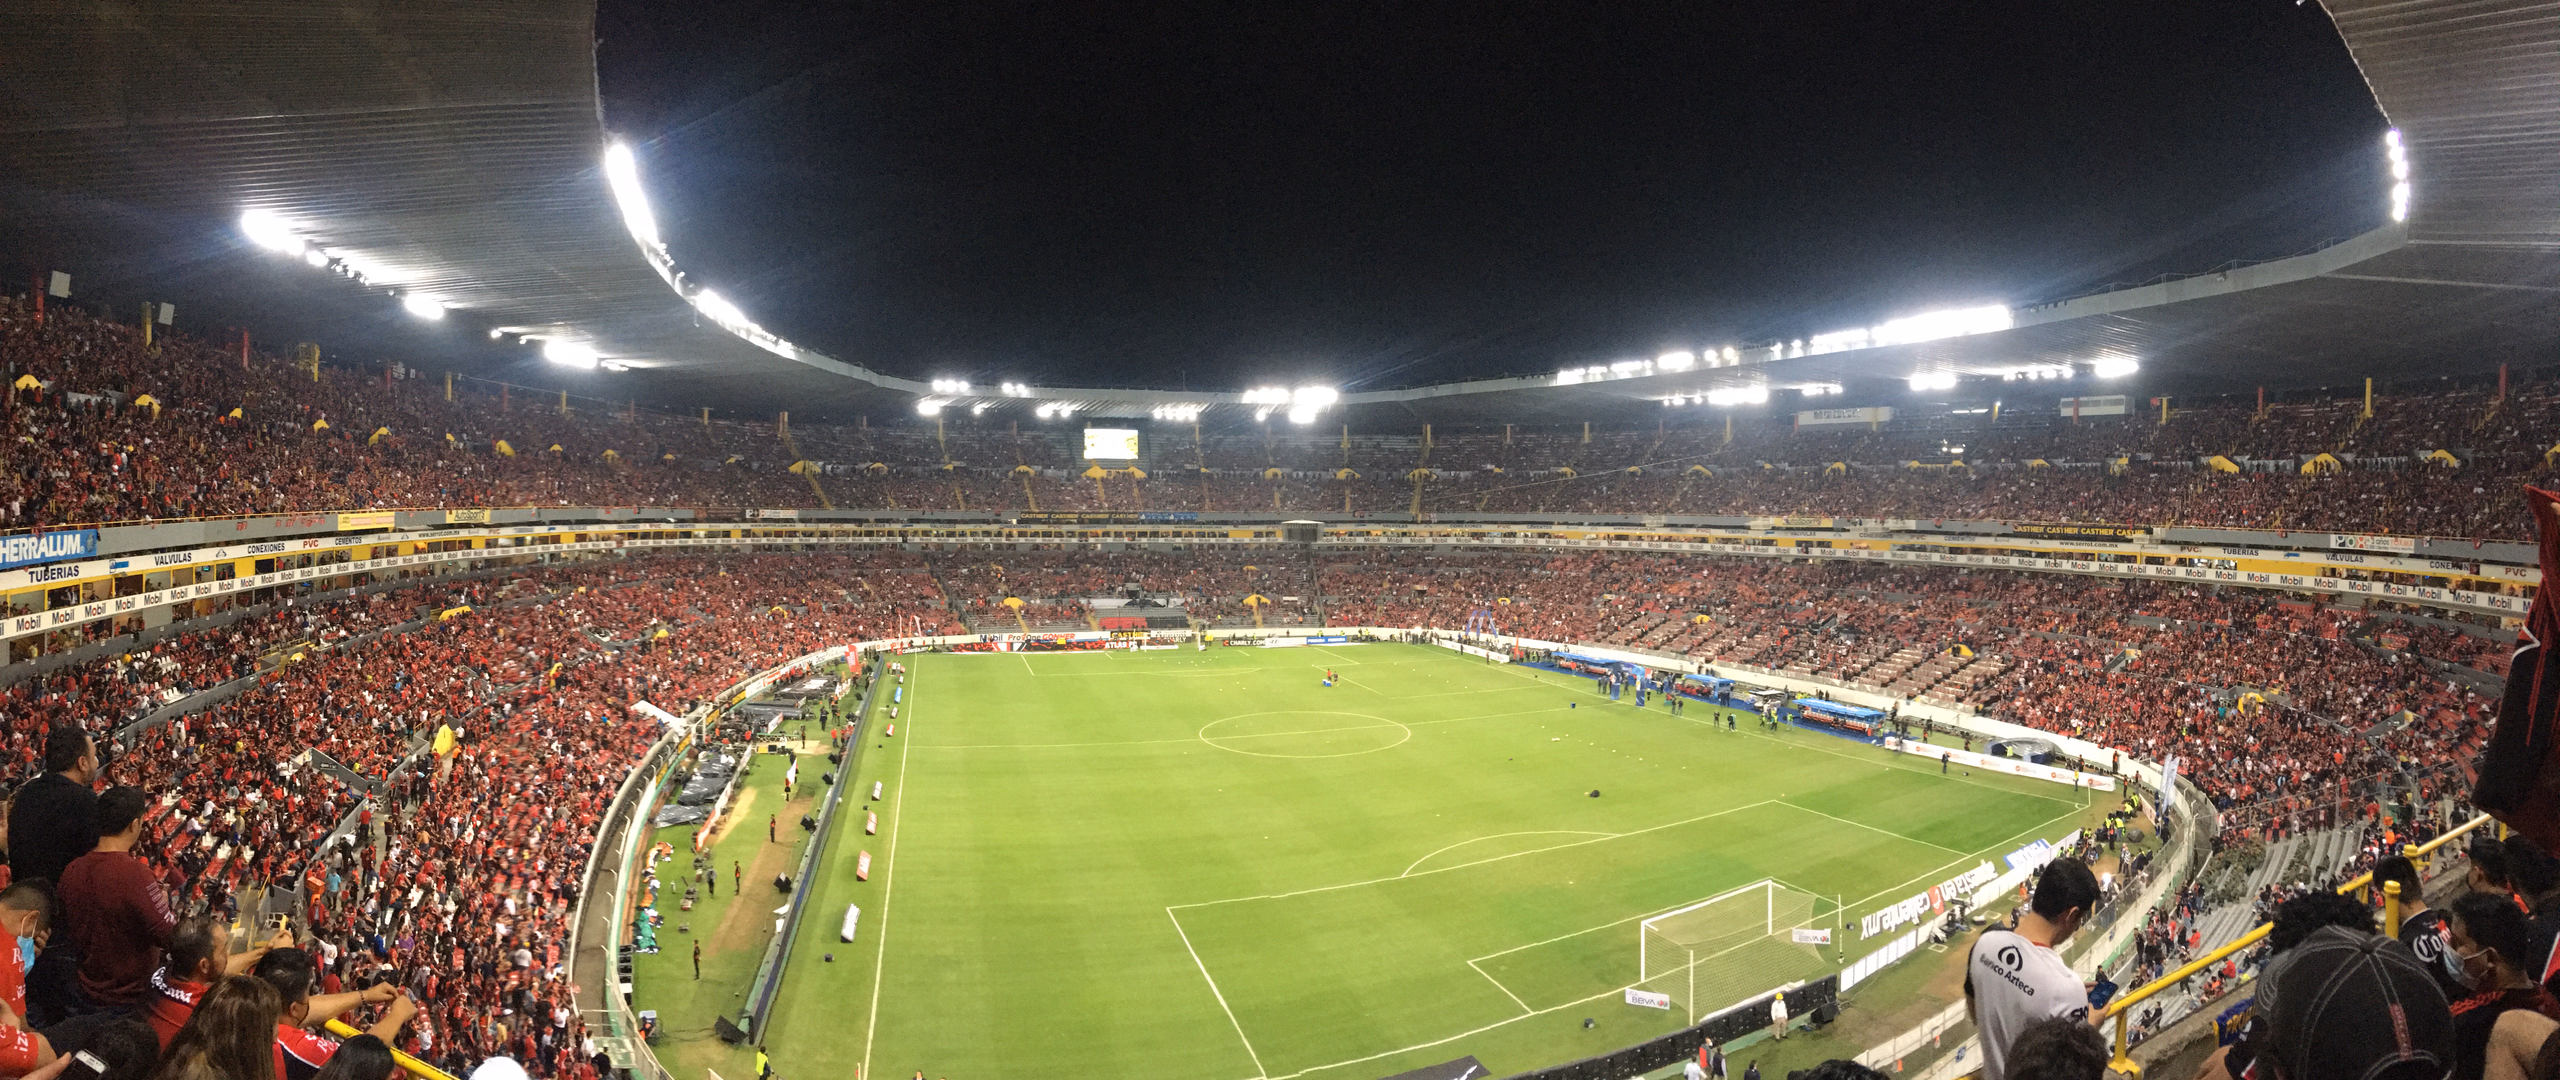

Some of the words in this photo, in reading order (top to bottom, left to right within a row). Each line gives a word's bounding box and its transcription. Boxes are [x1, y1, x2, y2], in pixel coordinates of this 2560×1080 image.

[2081, 527, 2113, 535] CASTHER
[303, 540, 318, 548] PVC
[335, 537, 362, 546] CEMENTOS
[0, 533, 81, 564] HERRALUM
[247, 543, 285, 554] CONEXIONES
[2222, 548, 2259, 556] TUBERIAS
[154, 553, 192, 566] VALVULAS
[371, 558, 382, 568] Mobil
[387, 556, 398, 566] Mobil
[2018, 558, 2036, 566] Mobil
[2326, 554, 2364, 563] VALVULAS
[319, 565, 331, 574] Mobil
[337, 562, 349, 572] Mobil
[354, 560, 366, 570] Mobil
[2071, 562, 2090, 570] Mobil
[2099, 563, 2118, 572] Mobil
[2127, 565, 2146, 573] Mobil
[29, 565, 79, 583] TUBERIAS
[281, 570, 294, 581] Mobil
[300, 567, 313, 577] Mobil
[2156, 567, 2176, 576] Mobil
[2186, 568, 2206, 578] Mobil
[2216, 570, 2237, 580] Mobil
[2505, 568, 2527, 577] PVC
[241, 577, 255, 588] Mobil
[261, 573, 275, 585] Mobil
[2247, 573, 2269, 582] Mobil
[2280, 576, 2303, 585] Mobil
[219, 579, 234, 592] Mobil
[2314, 578, 2337, 588] Mobil
[2349, 579, 2372, 592] Mobil
[195, 584, 212, 596] Mobil
[2384, 582, 2407, 595] Mobil
[2418, 587, 2441, 600] Mobil
[144, 592, 162, 606] Mobil
[171, 588, 188, 601] Mobil
[2453, 592, 2476, 604] Mobil
[116, 598, 135, 611] Mobil
[2488, 596, 2512, 609] Mobil
[85, 603, 106, 617] Mobil
[52, 610, 74, 625] Mobil
[16, 616, 40, 632] Mobil
[1860, 892, 1930, 940] caliente.mx
[1979, 953, 2004, 976] Banco
[2004, 971, 2035, 997] Azteca
[1632, 997, 1655, 1005] BBVA
